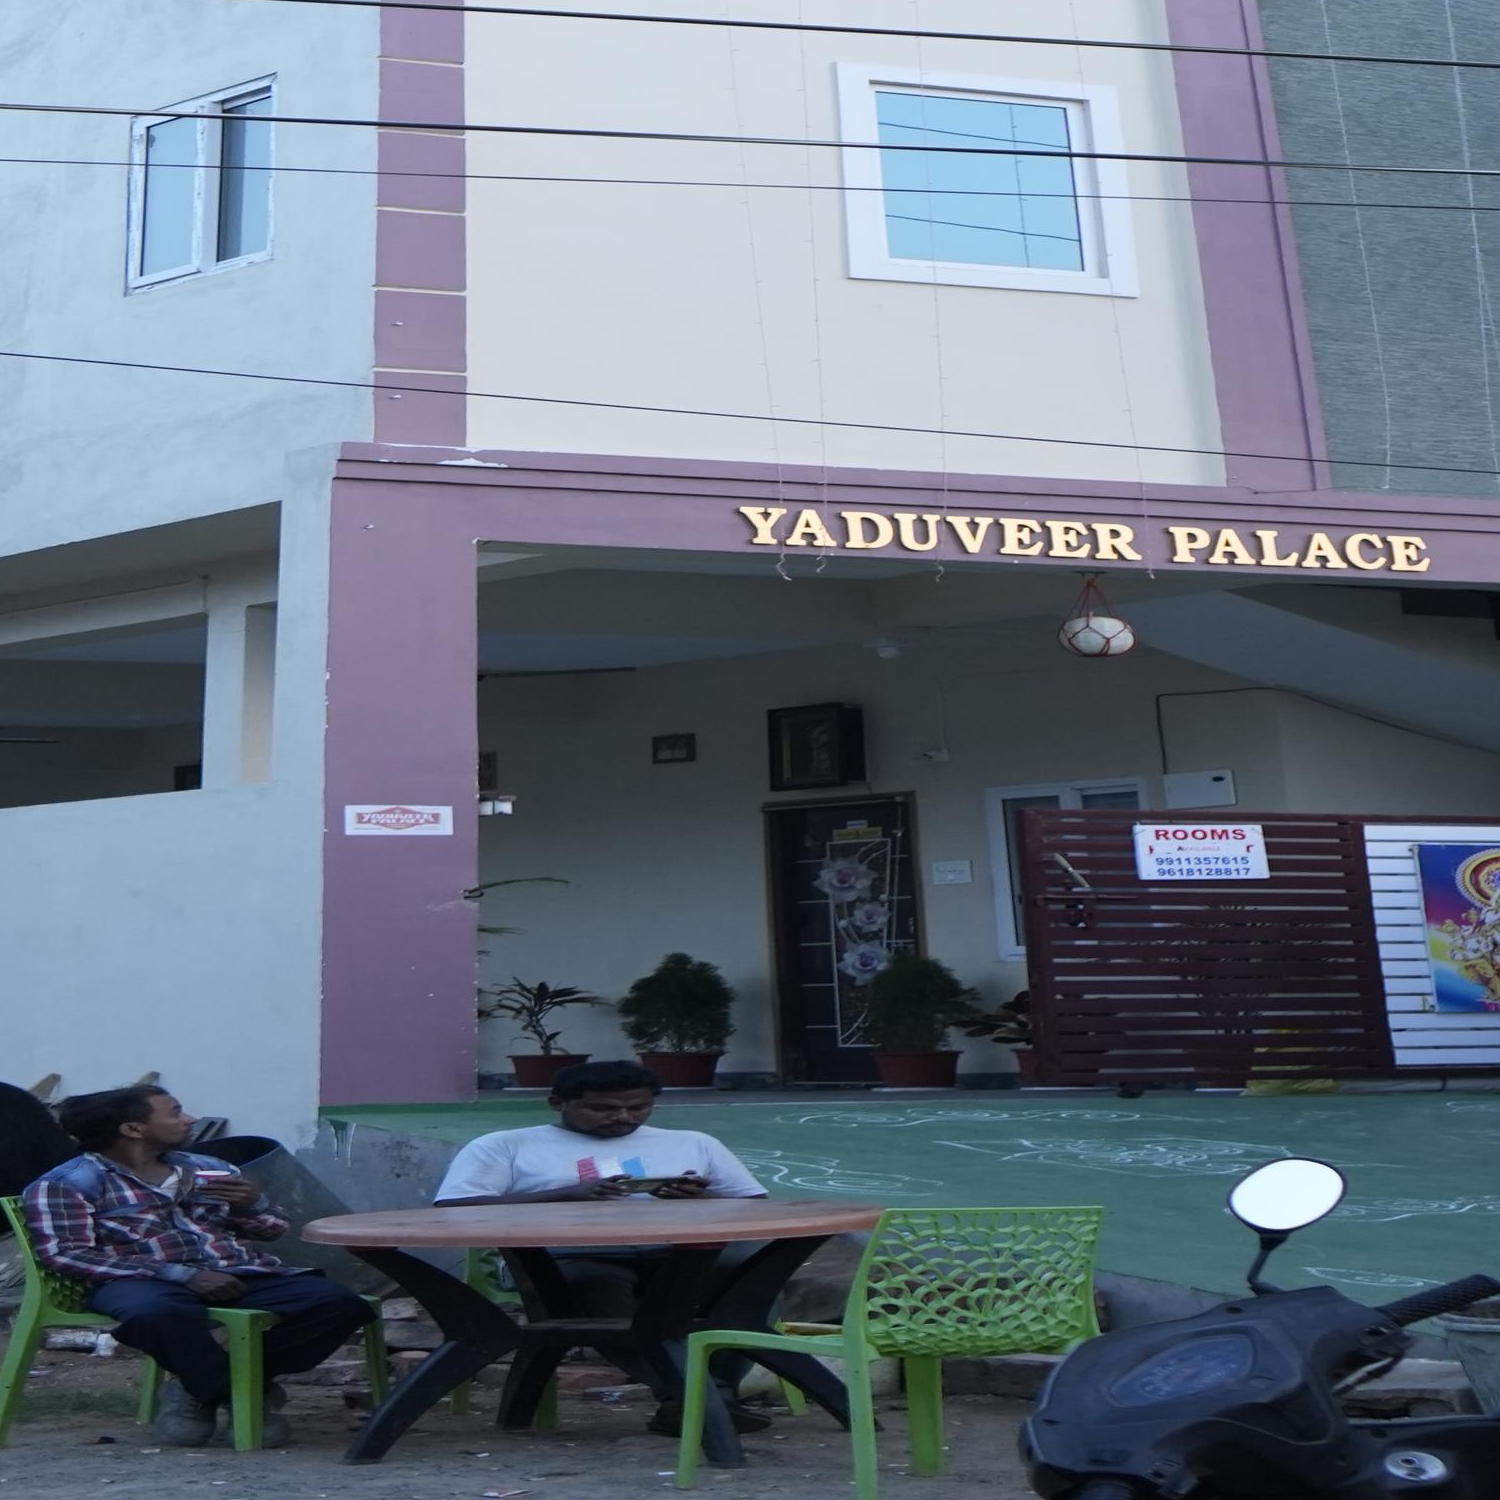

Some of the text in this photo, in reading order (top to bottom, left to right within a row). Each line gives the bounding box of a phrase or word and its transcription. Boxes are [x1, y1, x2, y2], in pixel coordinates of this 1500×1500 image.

[738, 505, 1431, 572] YADUVEER PALACE
[1154, 828, 1247, 841] ROOMS
[1155, 856, 1250, 866] 9911357615
[1156, 867, 1252, 877] 9618128817
